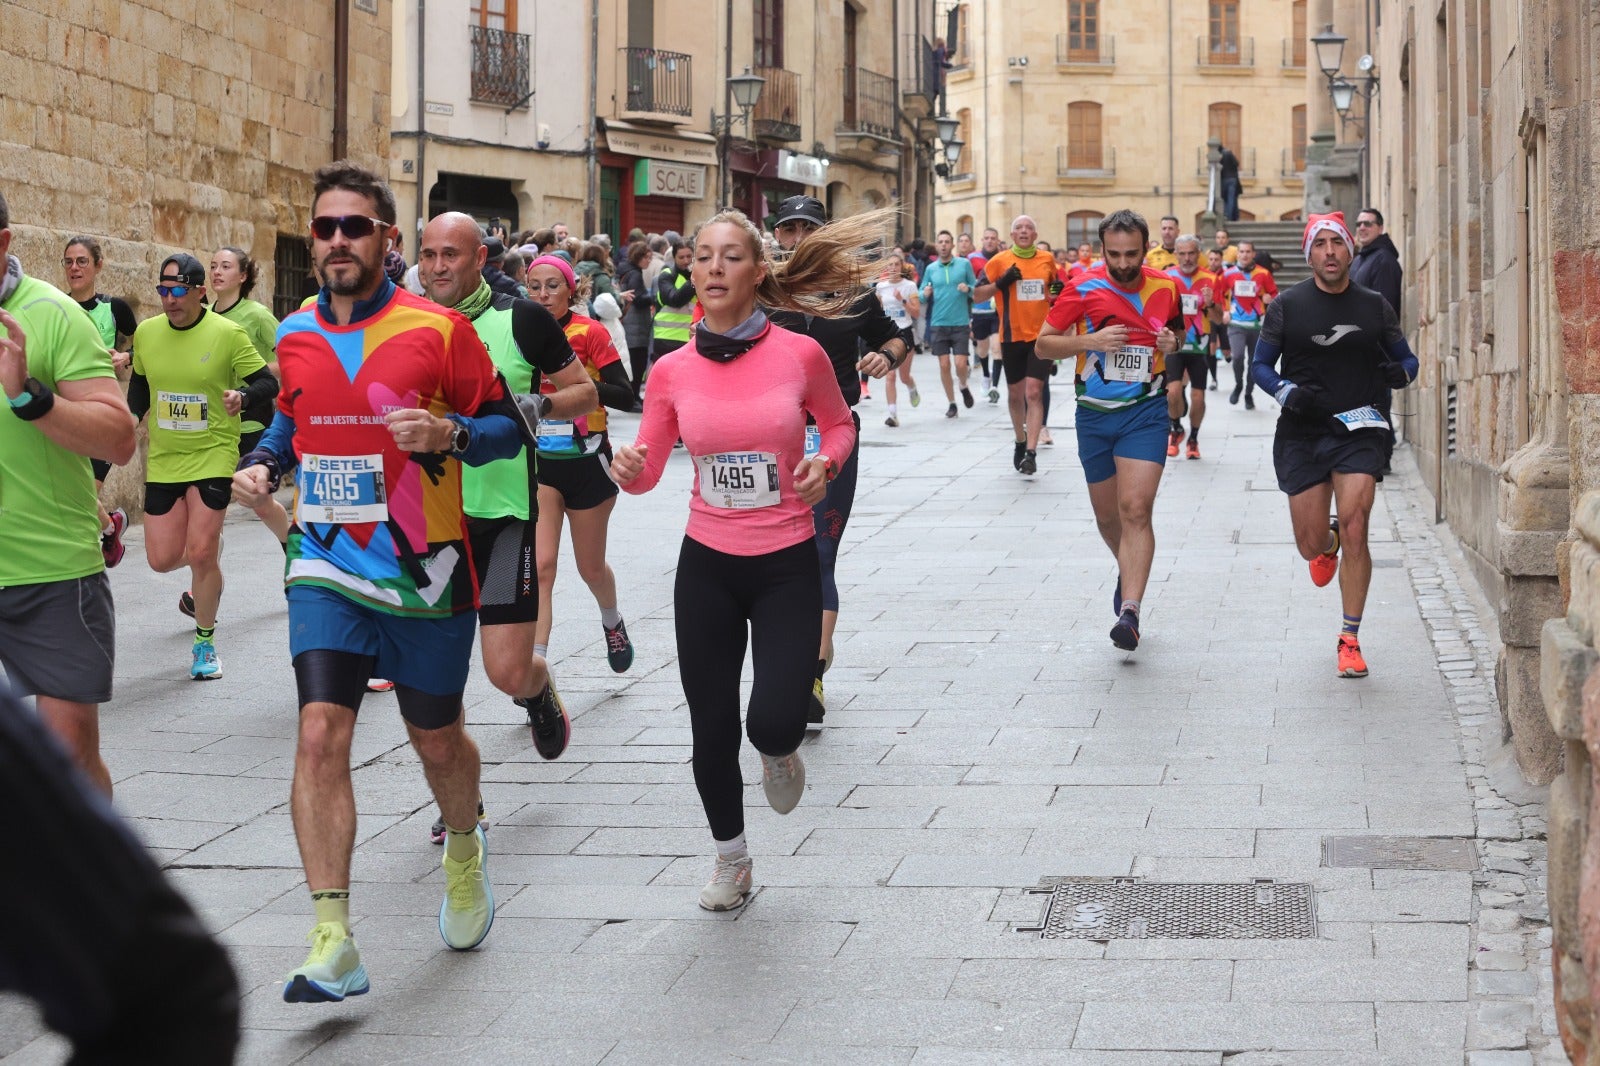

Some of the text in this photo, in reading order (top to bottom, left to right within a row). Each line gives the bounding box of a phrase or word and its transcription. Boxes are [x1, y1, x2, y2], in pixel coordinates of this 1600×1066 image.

[656, 169, 697, 194] SCALE
[1114, 353, 1141, 369] 1209
[169, 394, 202, 402] SETEL
[169, 402, 189, 418] 144
[1343, 408, 1377, 422] 3900
[309, 415, 322, 425] SAN
[323, 415, 358, 425] SILVESTRE
[319, 459, 374, 471] SETEL
[716, 454, 769, 464] SETEL
[711, 465, 755, 488] 1495
[313, 473, 360, 500] 4195
